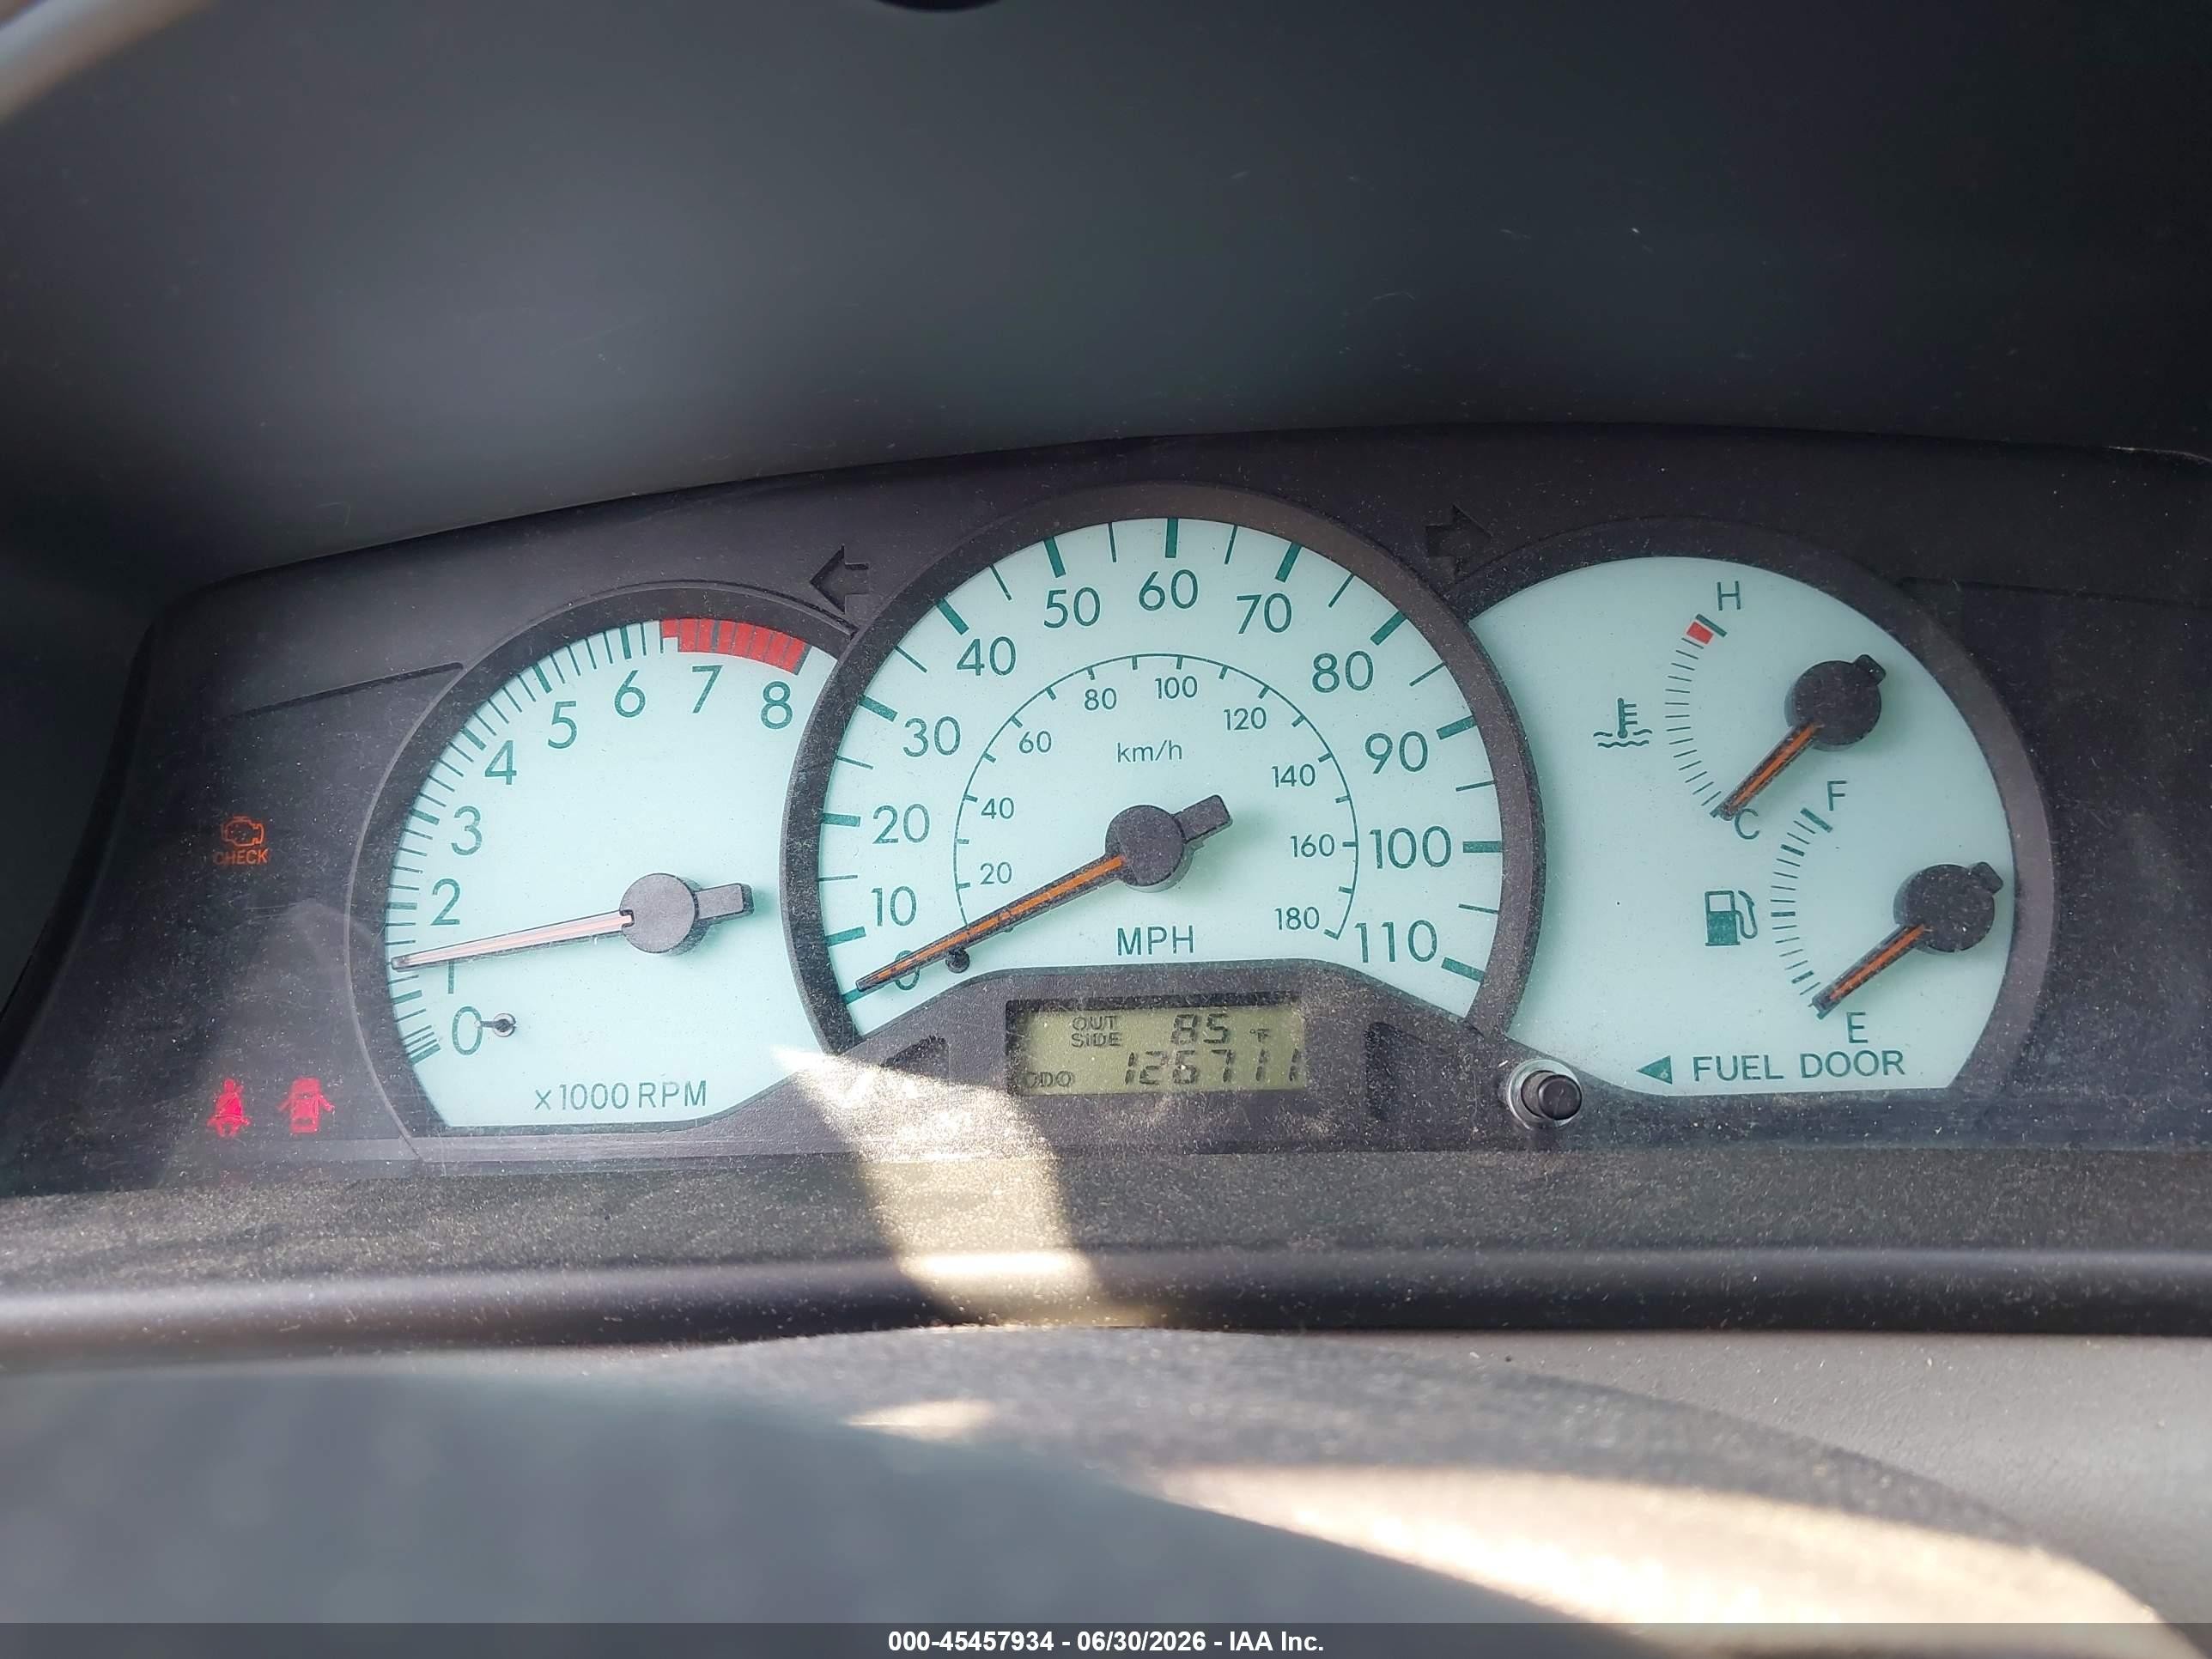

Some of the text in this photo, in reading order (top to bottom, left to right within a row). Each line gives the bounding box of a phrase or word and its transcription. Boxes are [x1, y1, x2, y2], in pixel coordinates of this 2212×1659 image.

[1139, 569, 1198, 611] 60
[1717, 580, 1741, 611] H
[1044, 587, 1100, 628] 50
[1237, 593, 1291, 634] 70
[957, 636, 1016, 677] 40
[1312, 651, 1373, 693] 80
[615, 670, 646, 718] 6
[692, 665, 723, 714] 7
[1085, 688, 1116, 710] 80
[1155, 676, 1197, 699] 100
[761, 681, 793, 729] 8
[1224, 707, 1267, 730] 120
[548, 701, 577, 749] 5
[903, 716, 960, 757] 30
[1019, 731, 1051, 753] 60
[1118, 740, 1182, 763] km/h
[1365, 732, 1428, 774] 90
[483, 740, 518, 786] 4
[1272, 764, 1316, 787] 140
[981, 798, 1014, 819] 40
[1827, 781, 1847, 811] F
[451, 805, 482, 855] 3
[872, 804, 929, 844] 20
[1734, 808, 1760, 840] C
[216, 848, 269, 866] CHECK
[1291, 834, 1334, 857] 160
[1374, 827, 1451, 869] 100
[981, 862, 1012, 884] 20
[430, 878, 460, 926] 2
[872, 886, 916, 927] 10
[1275, 907, 1319, 930] 180
[1118, 926, 1193, 956] MPH
[1357, 921, 1437, 963] 110
[452, 1006, 483, 1055] 0
[1072, 1032, 1122, 1047] SIDE
[1073, 1017, 1116, 1030] OUT
[1171, 1014, 1229, 1044] 85
[1846, 1012, 1869, 1043] E
[1124, 1048, 1298, 1085] 126711
[1693, 1050, 1905, 1081] FUEL DOOR
[639, 1080, 706, 1108] RPM
